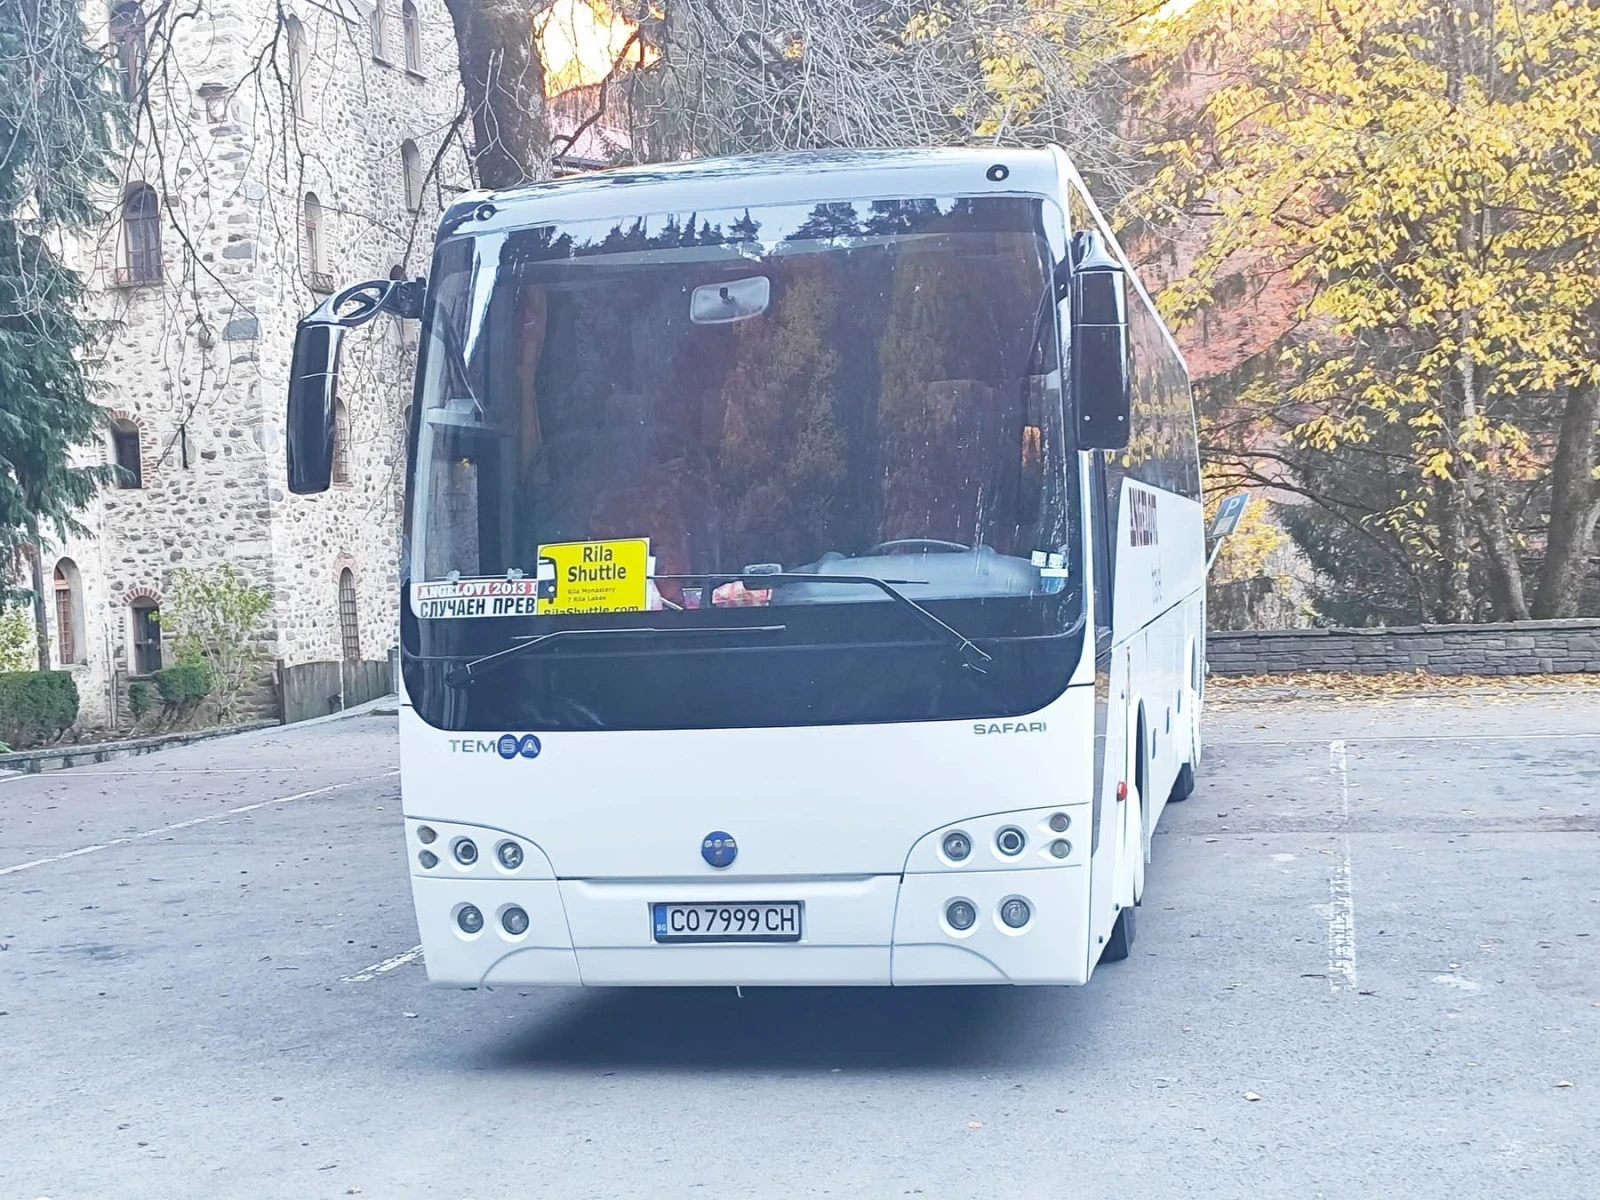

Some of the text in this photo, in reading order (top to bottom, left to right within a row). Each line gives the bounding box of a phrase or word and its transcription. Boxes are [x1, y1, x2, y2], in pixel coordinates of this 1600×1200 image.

[1223, 497, 1241, 517] P
[583, 545, 613, 563] Rila
[567, 563, 627, 583] Shuttle
[419, 582, 492, 599] ANGELOVI
[493, 581, 527, 596] 2013
[420, 597, 536, 618] СЛУЧАЕН ПРЕВ
[544, 605, 639, 615] RilaShuttlecom
[973, 722, 1047, 735] SAFARI
[449, 737, 540, 756] TEMSA
[656, 923, 667, 932] BG
